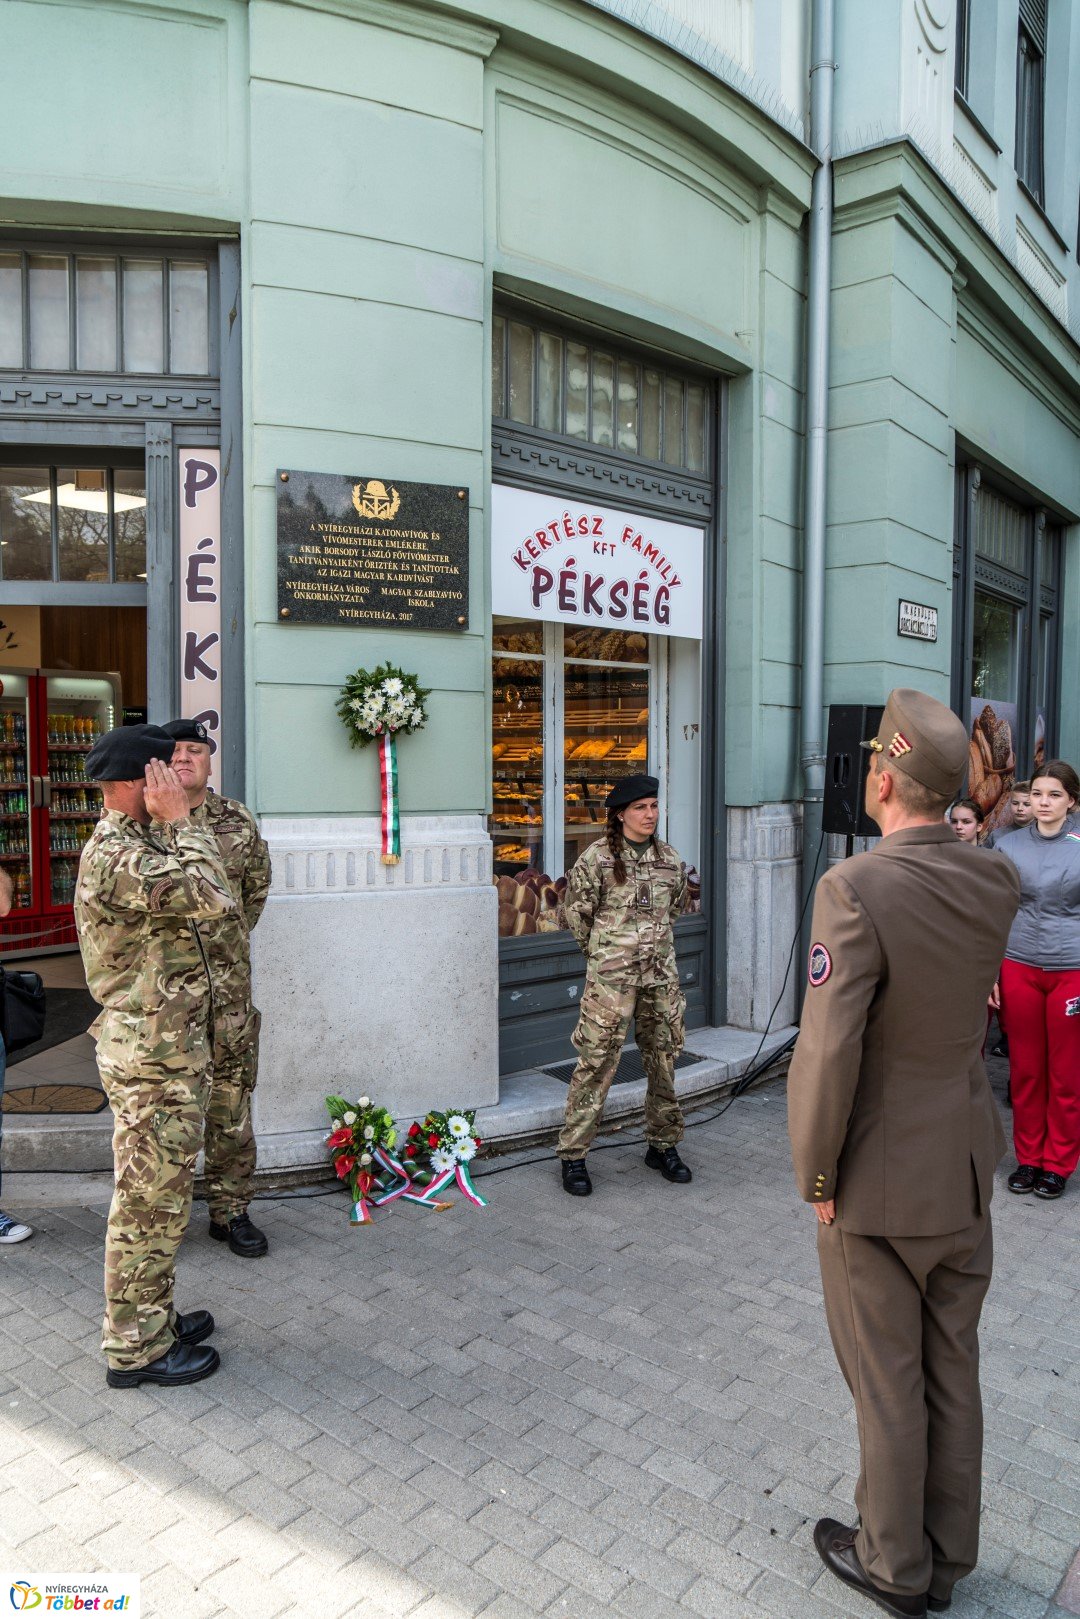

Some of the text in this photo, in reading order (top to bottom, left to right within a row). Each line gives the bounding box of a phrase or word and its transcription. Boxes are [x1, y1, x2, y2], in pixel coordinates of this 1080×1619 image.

[318, 523, 373, 535] NYÍREGYHÁZI
[375, 528, 428, 539] KATONAVÍVÓK
[431, 531, 440, 540] ÉS
[323, 535, 383, 547] VÍVÓMESTEREK
[300, 546, 449, 562] AKIK BORSODY LÁSZLÓ FŐVÍVÓMESTER
[513, 512, 682, 587] KERTÉSZ FAMILY
[593, 542, 616, 557] KFT
[288, 556, 460, 574] TANÍTVÁNYAIKÉNT ŐRIZTÉK ÉS TANÍTOTTÁK
[330, 569, 350, 578] IGAZI
[354, 571, 385, 580] MAGYAR
[387, 572, 434, 583] KARDVÍVÁST
[286, 580, 370, 594] NYÍREGYHÁZA VÁROS
[381, 587, 462, 599] MAGYAR SZABLYAVÍVÓ
[532, 558, 670, 625] PÉKSÉG
[294, 591, 364, 603] ÖNKORMÁNYZATA
[408, 599, 434, 607] ISKOLA
[399, 612, 412, 621] 2017
